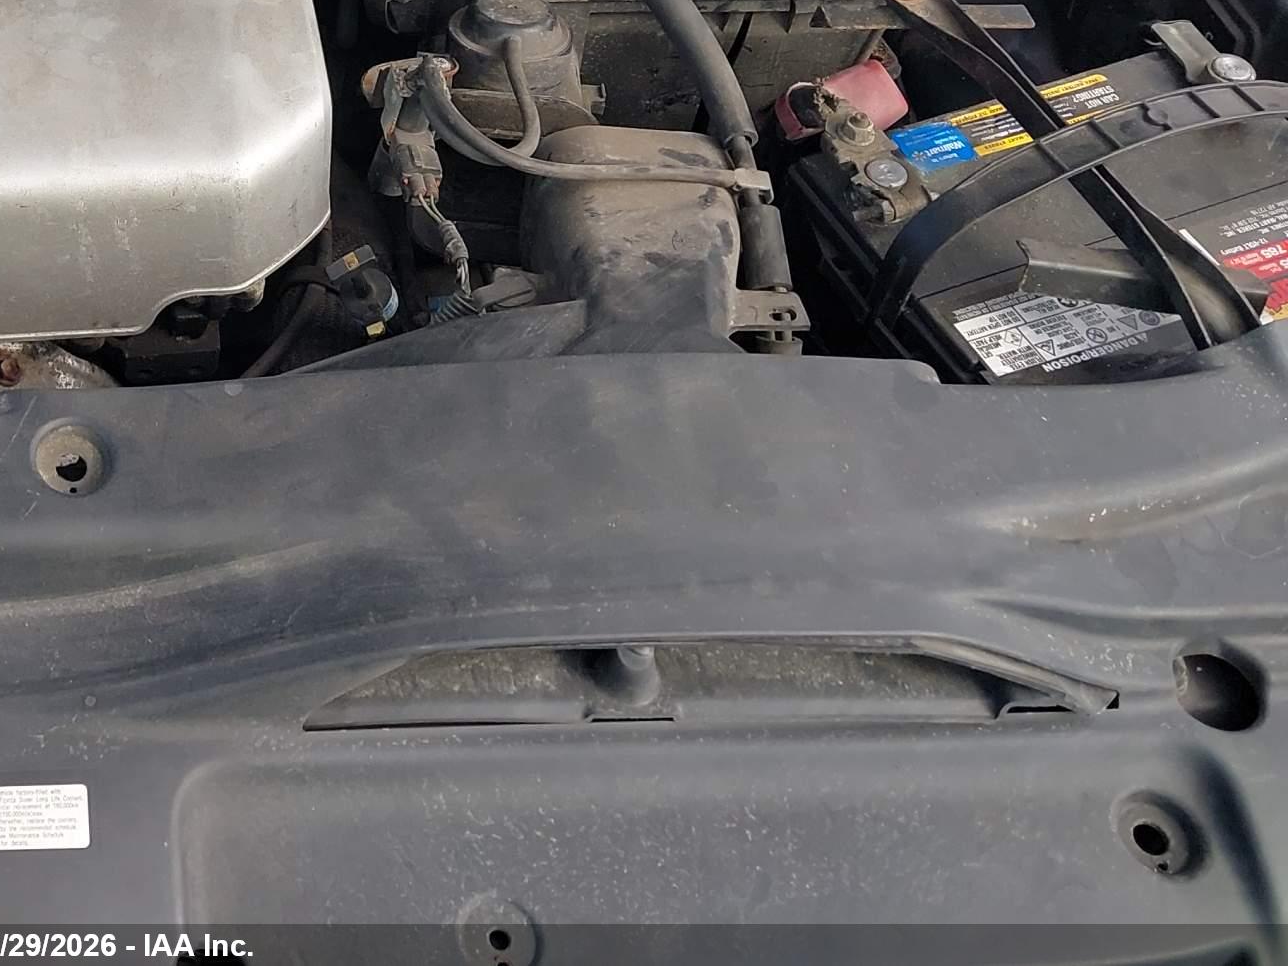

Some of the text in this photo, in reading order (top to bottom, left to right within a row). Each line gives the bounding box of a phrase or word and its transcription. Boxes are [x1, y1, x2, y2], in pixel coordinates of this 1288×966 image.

[1070, 83, 1114, 103] STARTING?
[1099, 92, 1120, 104] CAR
[1083, 97, 1103, 109] NOT
[923, 139, 965, 157] Walmart
[1039, 336, 1140, 372] DANGER/POISON
